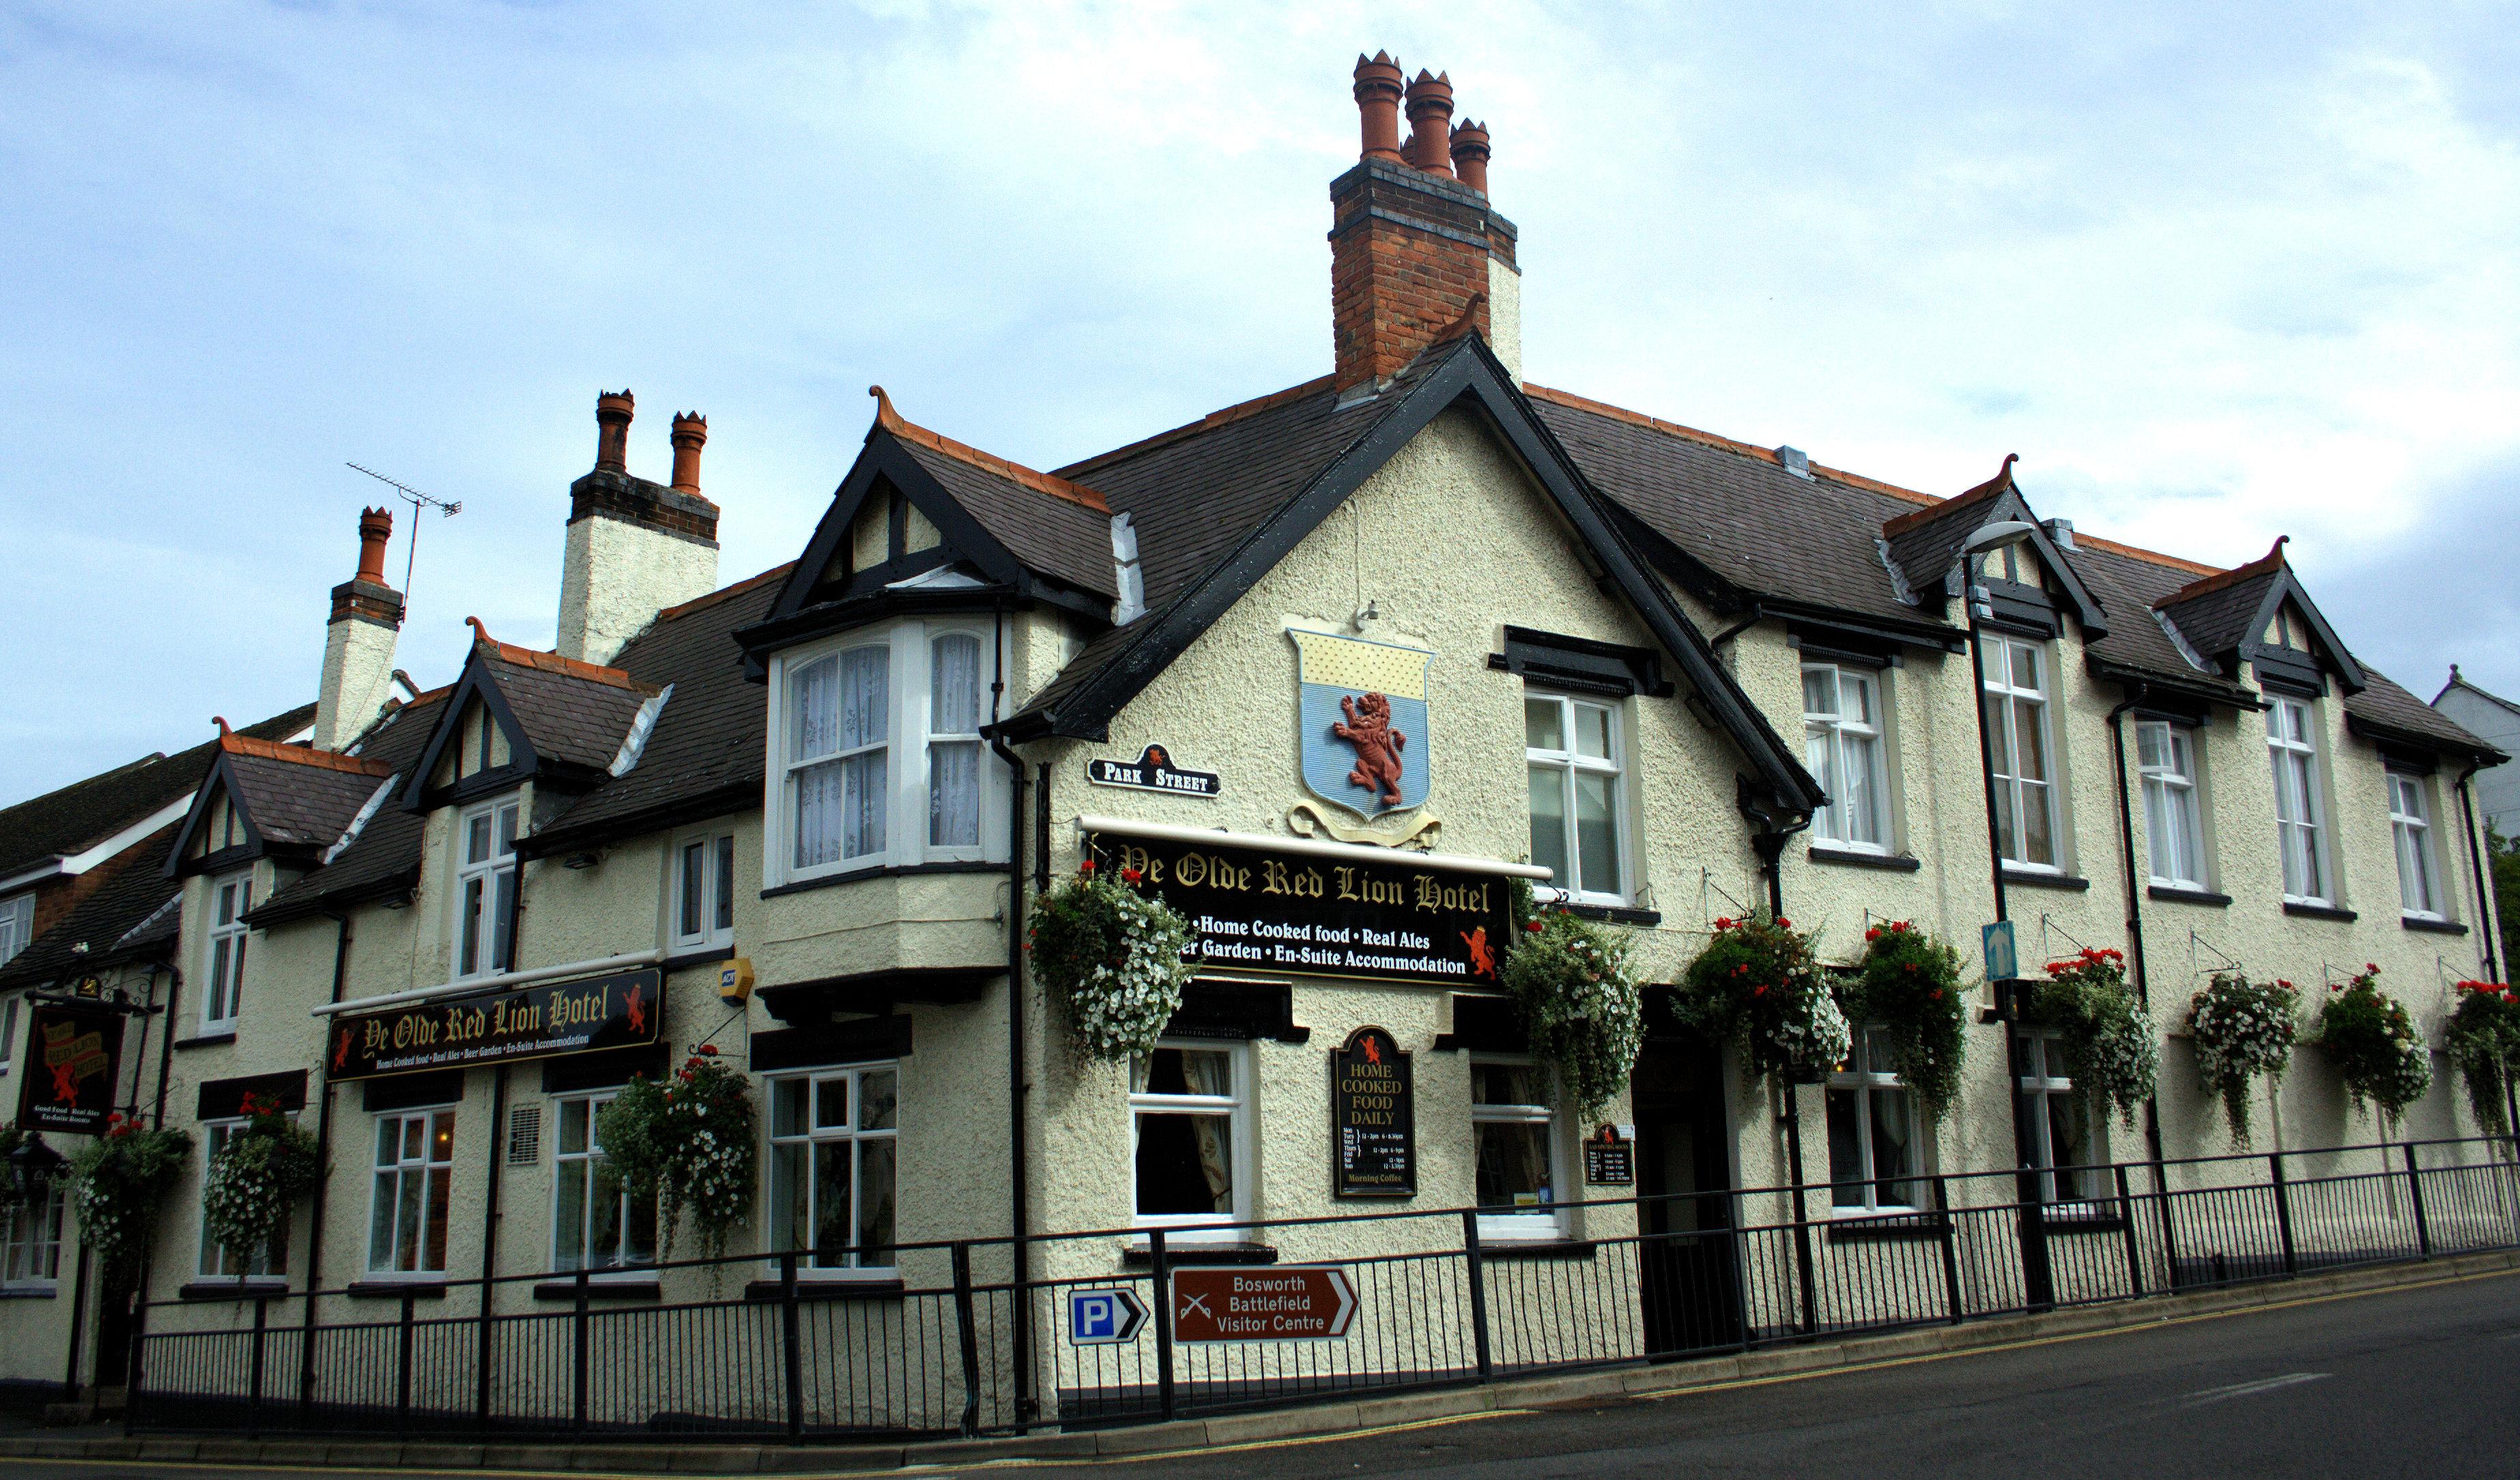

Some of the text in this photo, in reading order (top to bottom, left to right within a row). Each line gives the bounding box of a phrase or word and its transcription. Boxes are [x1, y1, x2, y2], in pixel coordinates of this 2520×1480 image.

[1175, 852, 1251, 891] Olde
[1262, 859, 1323, 898] Red
[1334, 866, 1405, 906] Lion
[1414, 874, 1491, 915] Hotel
[1200, 915, 1431, 951] Home Cooked food Real Ales
[1201, 939, 1262, 961] Garden
[1274, 944, 1342, 967] En-Suite
[1345, 949, 1466, 975] Accommodation
[362, 984, 610, 1060] Ye Olde Red Lion Hotel
[376, 1058, 394, 1070] Home
[393, 1057, 415, 1068] Cooked
[433, 1051, 446, 1062] Real
[446, 1049, 460, 1061] Ales
[464, 1047, 479, 1059] Beer
[479, 1045, 502, 1057] Garden
[506, 1041, 534, 1054] En-Suite
[534, 1033, 590, 1050] Accommodation
[1351, 1064, 1393, 1078] HOME
[1342, 1079, 1402, 1094] COOKED
[1352, 1096, 1393, 1110] FOOD
[1351, 1112, 1395, 1126] DAILY
[1349, 1174, 1403, 1183] Morning Coffee
[1233, 1276, 1306, 1292] Bosworth
[1229, 1296, 1311, 1312] Battlefield
[1083, 1299, 1108, 1335] P
[1217, 1314, 1324, 1333] Visitor Centre
